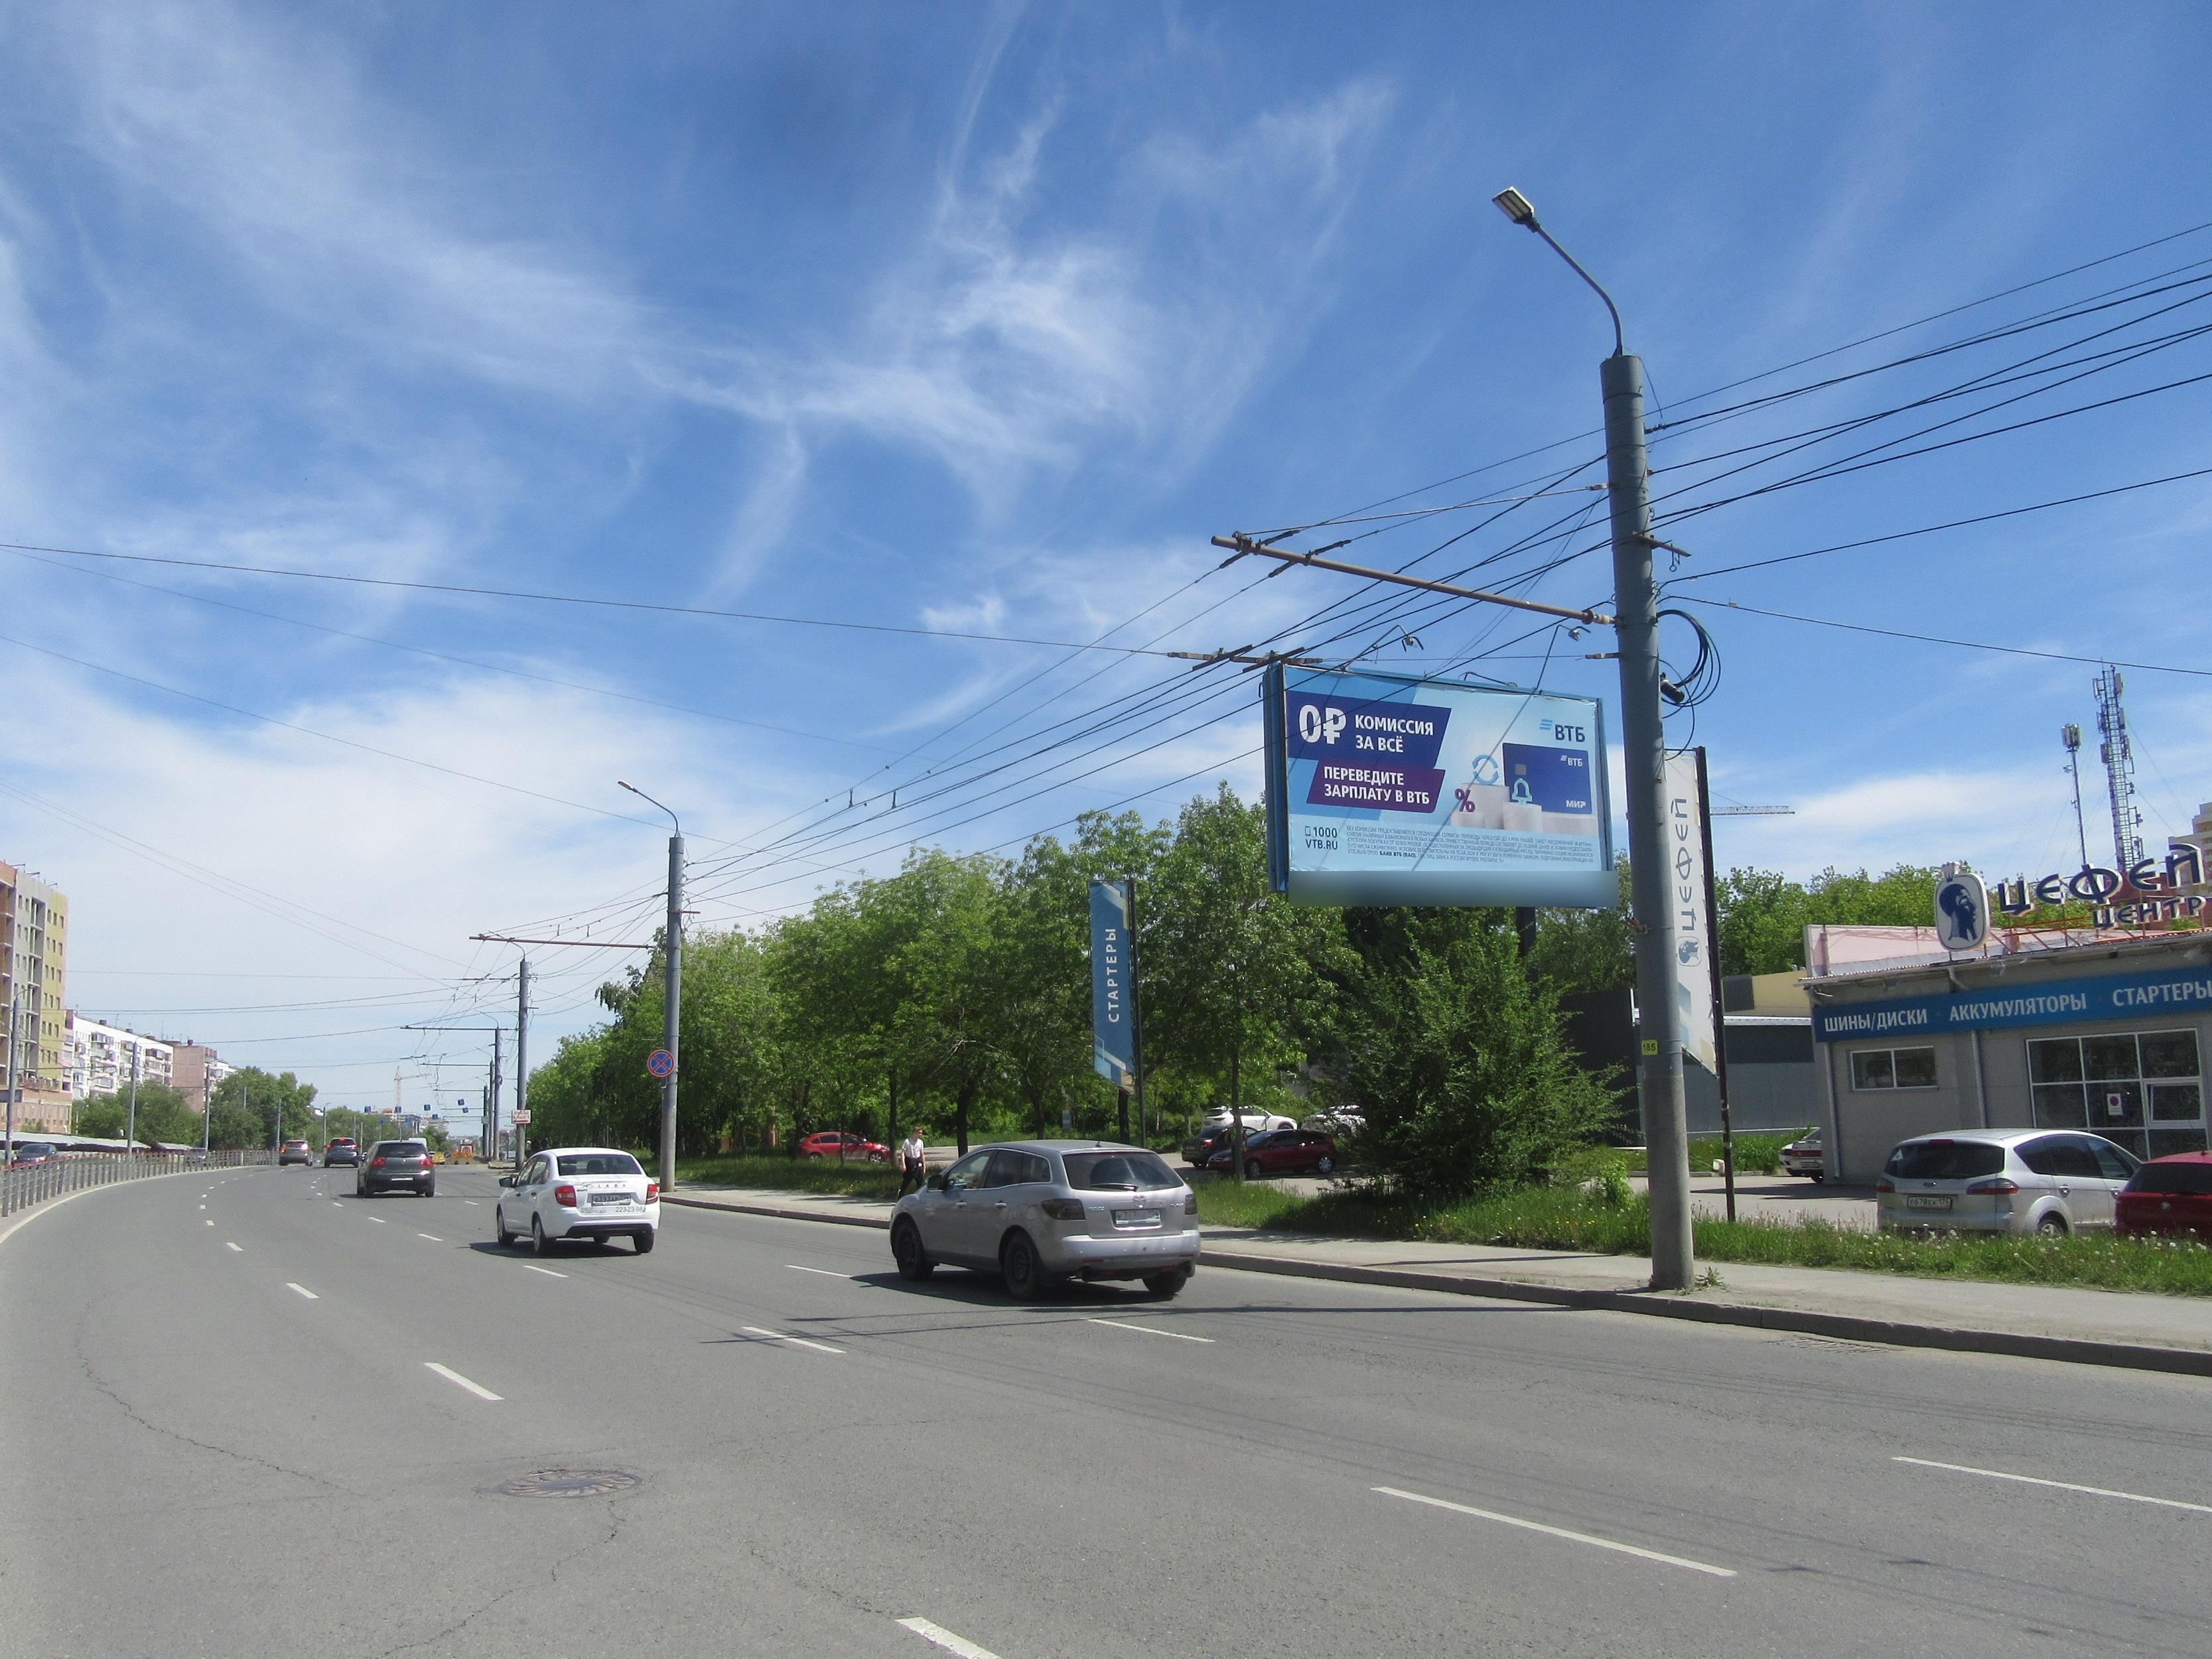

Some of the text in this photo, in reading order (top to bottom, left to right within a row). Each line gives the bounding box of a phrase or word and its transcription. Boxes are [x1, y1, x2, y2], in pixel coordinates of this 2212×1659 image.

[1355, 714, 1434, 736] КОМИССИЯ
[1555, 724, 1586, 743] ВТБ
[1355, 735, 1404, 753] ЗА ВСЁ
[1568, 758, 1583, 767] ВТБ
[1324, 766, 1405, 786] ПЕРЕВЕДИТЕ
[1324, 783, 1430, 805] ЗАРПЛАТУ В ВТБ
[1566, 800, 1586, 809] МИР
[1313, 827, 1338, 838] 1000
[1306, 839, 1338, 850] VTB.RU
[1671, 798, 1696, 931] ЦЕФЕЙ
[1998, 842, 2205, 916] ЦЕФЕЙ
[2093, 896, 2206, 929] ЦЕНТР
[1106, 929, 1119, 1022] СТАРТЕРЫ
[1825, 980, 2212, 1032] ШИНЫ/ДИСКИ АККУМУЛЯТОРЫ СТАРТЕРЫ
[1643, 1043, 1656, 1051] 185
